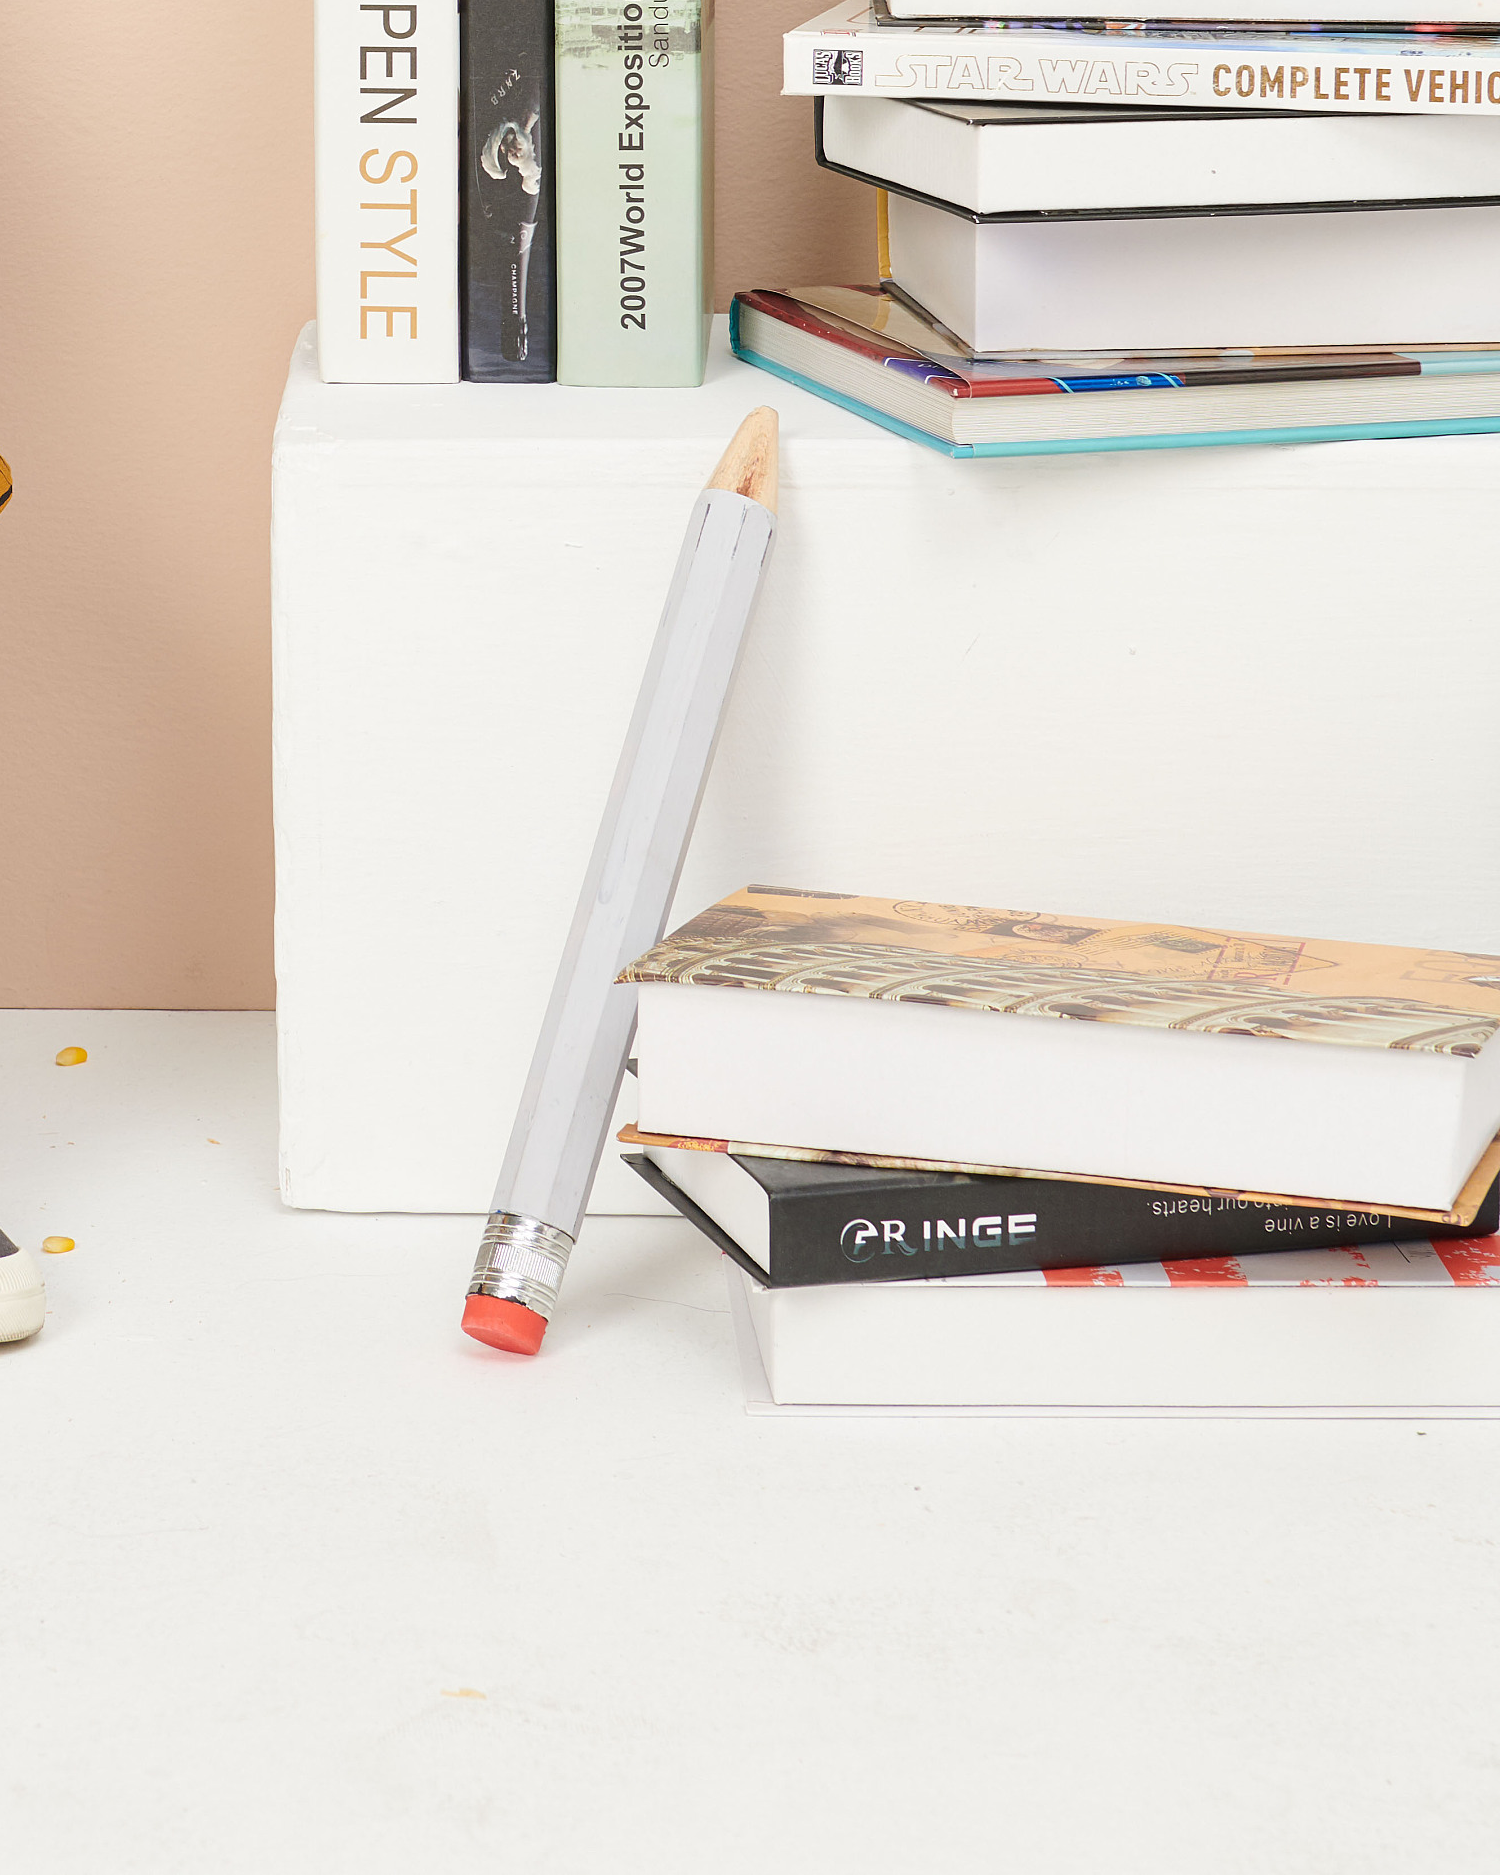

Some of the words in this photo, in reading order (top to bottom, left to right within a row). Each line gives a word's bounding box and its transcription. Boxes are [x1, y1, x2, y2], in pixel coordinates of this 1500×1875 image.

[875, 54, 1034, 92] STAR
[1038, 59, 1199, 97] WARS
[1212, 63, 1392, 102] COMPLETE
[359, 149, 418, 340] STYLE
[618, 163, 646, 330] 2007World
[510, 263, 519, 316] CHAMPAGNE
[1146, 1198, 1212, 1218] hearts.
[1310, 1216, 1320, 1229] a
[1326, 1215, 1340, 1232] is
[1264, 1216, 1304, 1235] vine
